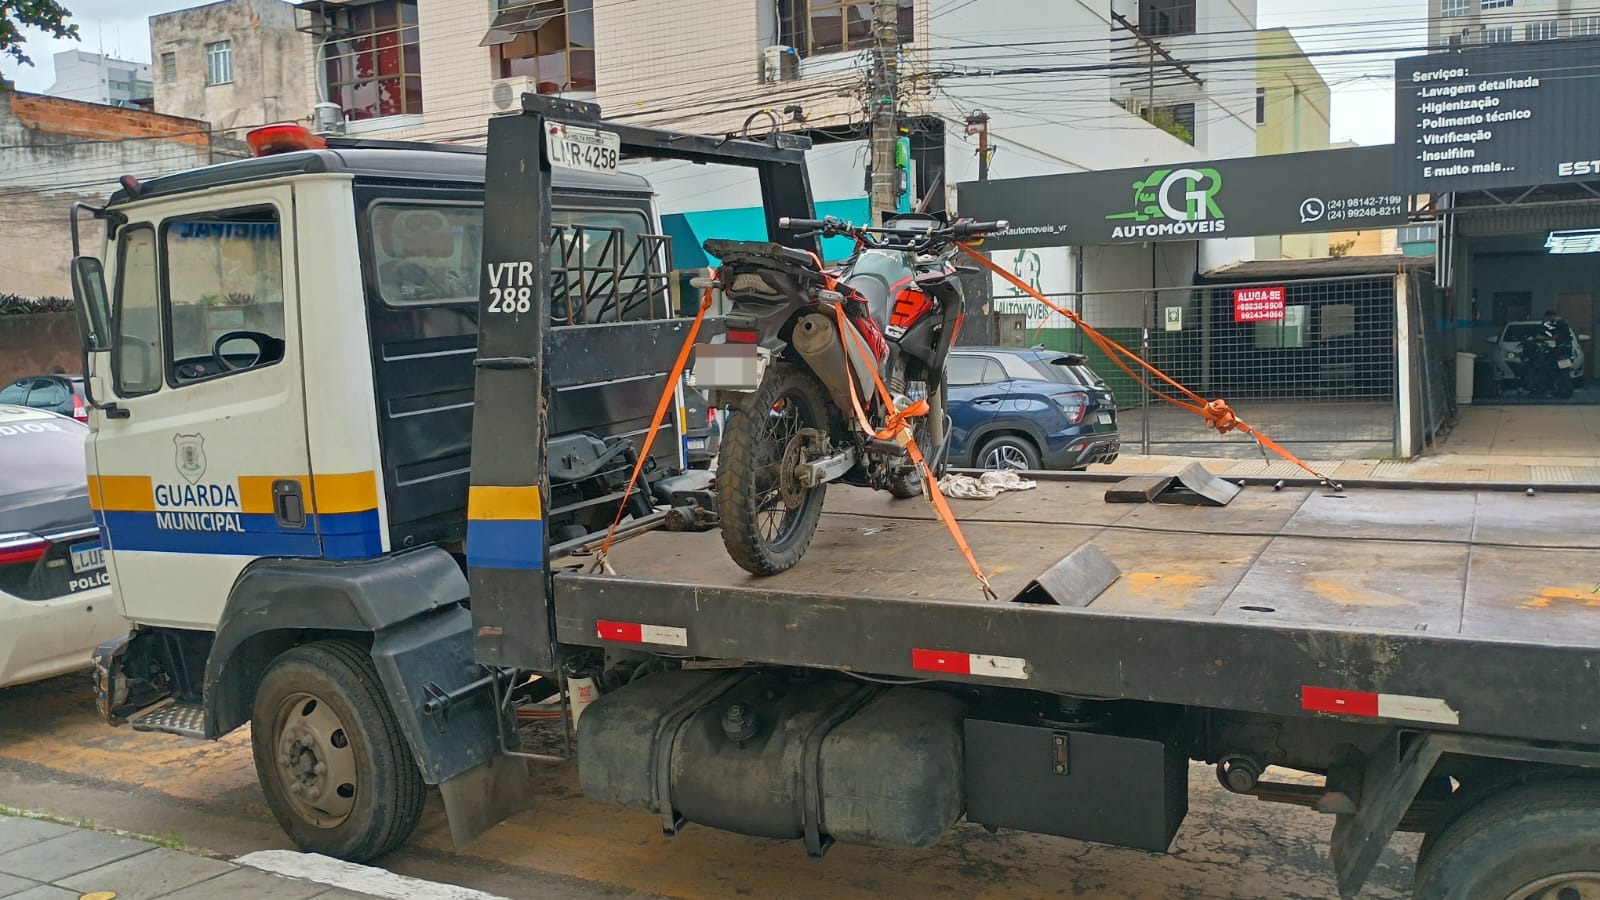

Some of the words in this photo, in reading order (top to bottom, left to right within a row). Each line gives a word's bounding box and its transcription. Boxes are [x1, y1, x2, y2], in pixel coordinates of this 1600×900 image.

[1412, 68, 1469, 82] Serviços:
[1417, 83, 1476, 97] -Lavagem
[1479, 76, 1539, 92] detalhada
[1417, 96, 1500, 114] -Higienização
[1417, 114, 1483, 129] -Polimento
[1485, 108, 1532, 122] técnico
[1417, 130, 1492, 144] -Vitrificação
[1417, 147, 1475, 161] -Insulfilm
[1423, 167, 1432, 177] E
[1434, 164, 1470, 177] muito
[1472, 162, 1515, 173] mais...
[1327, 200, 1346, 210] (24)
[1347, 196, 1402, 207] 98142-7199
[1327, 210, 1346, 221] (24)
[1111, 219, 1226, 239] AUTOMÓVEIS
[488, 261, 533, 288] VTR
[488, 287, 531, 313] 288
[1238, 290, 1281, 302] ALUGA-SE
[155, 484, 239, 507] GUARDA
[155, 511, 246, 532] MUNICIPAL
